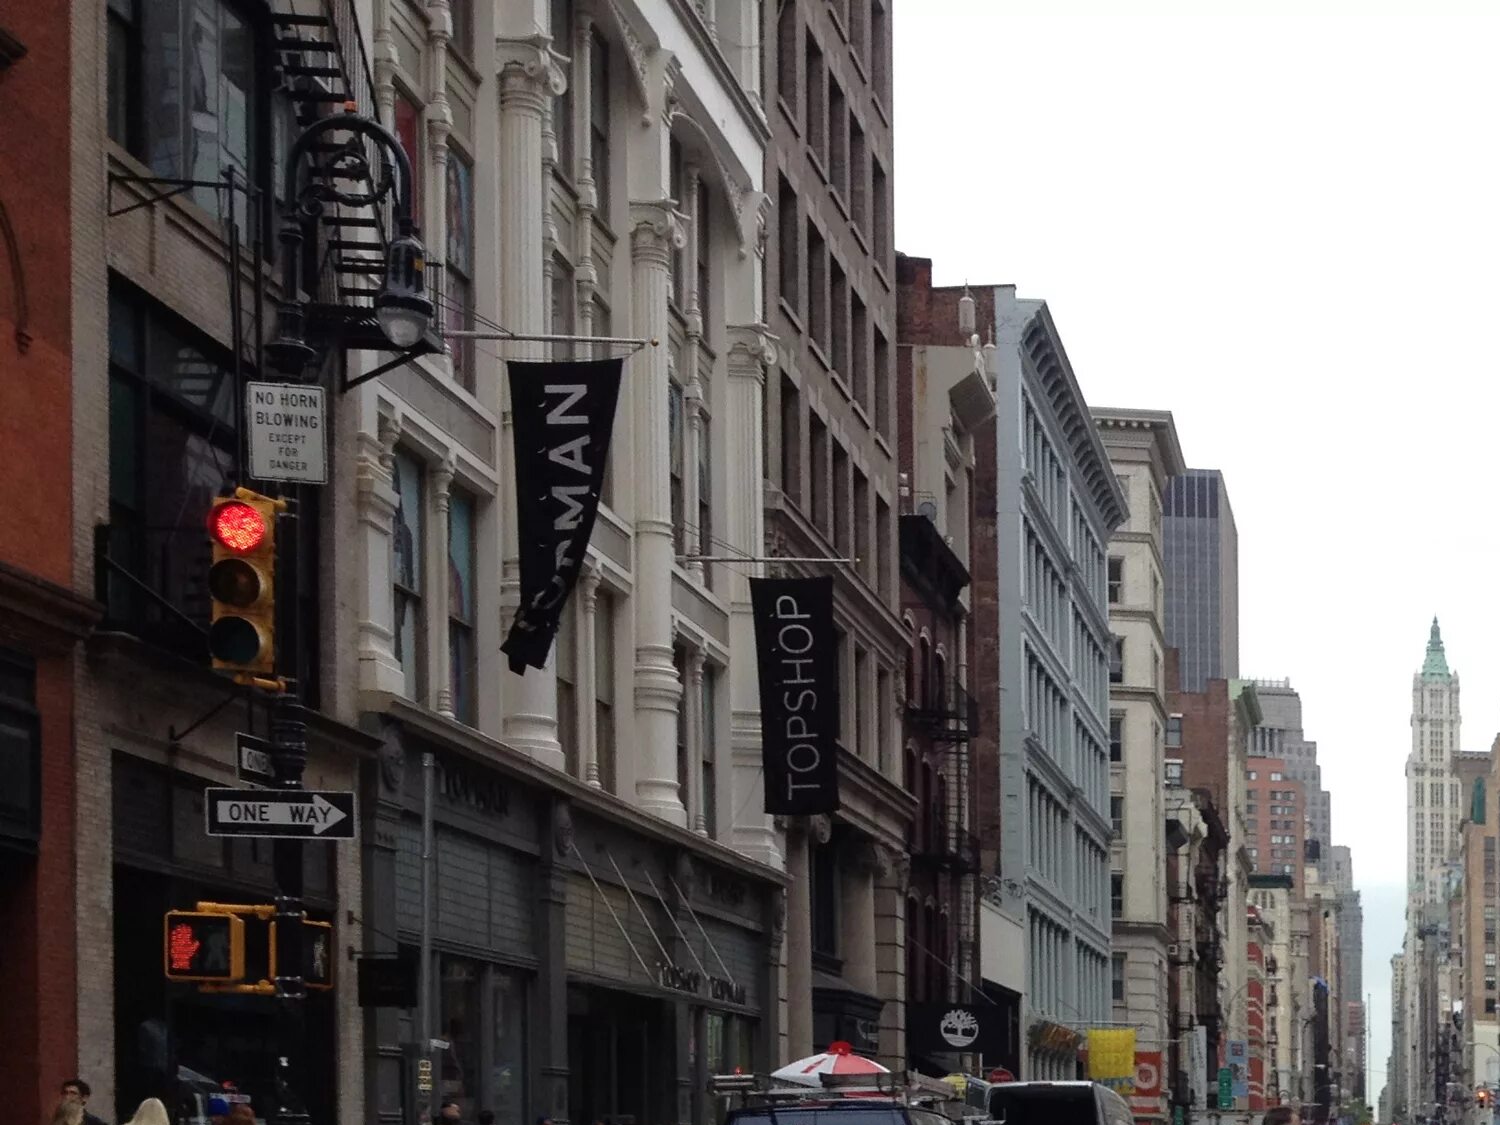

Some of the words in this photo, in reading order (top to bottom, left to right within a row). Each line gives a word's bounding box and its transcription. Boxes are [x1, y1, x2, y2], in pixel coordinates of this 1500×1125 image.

[255, 391, 274, 405] NO
[280, 393, 318, 408] HORN
[256, 411, 318, 429] BLOWING
[268, 433, 306, 444] EXCEPT
[278, 446, 298, 457] FOR
[269, 459, 308, 471] DANGER
[776, 595, 821, 801] TOPSHOP
[229, 803, 269, 822] ONE
[289, 805, 331, 823] WAY
